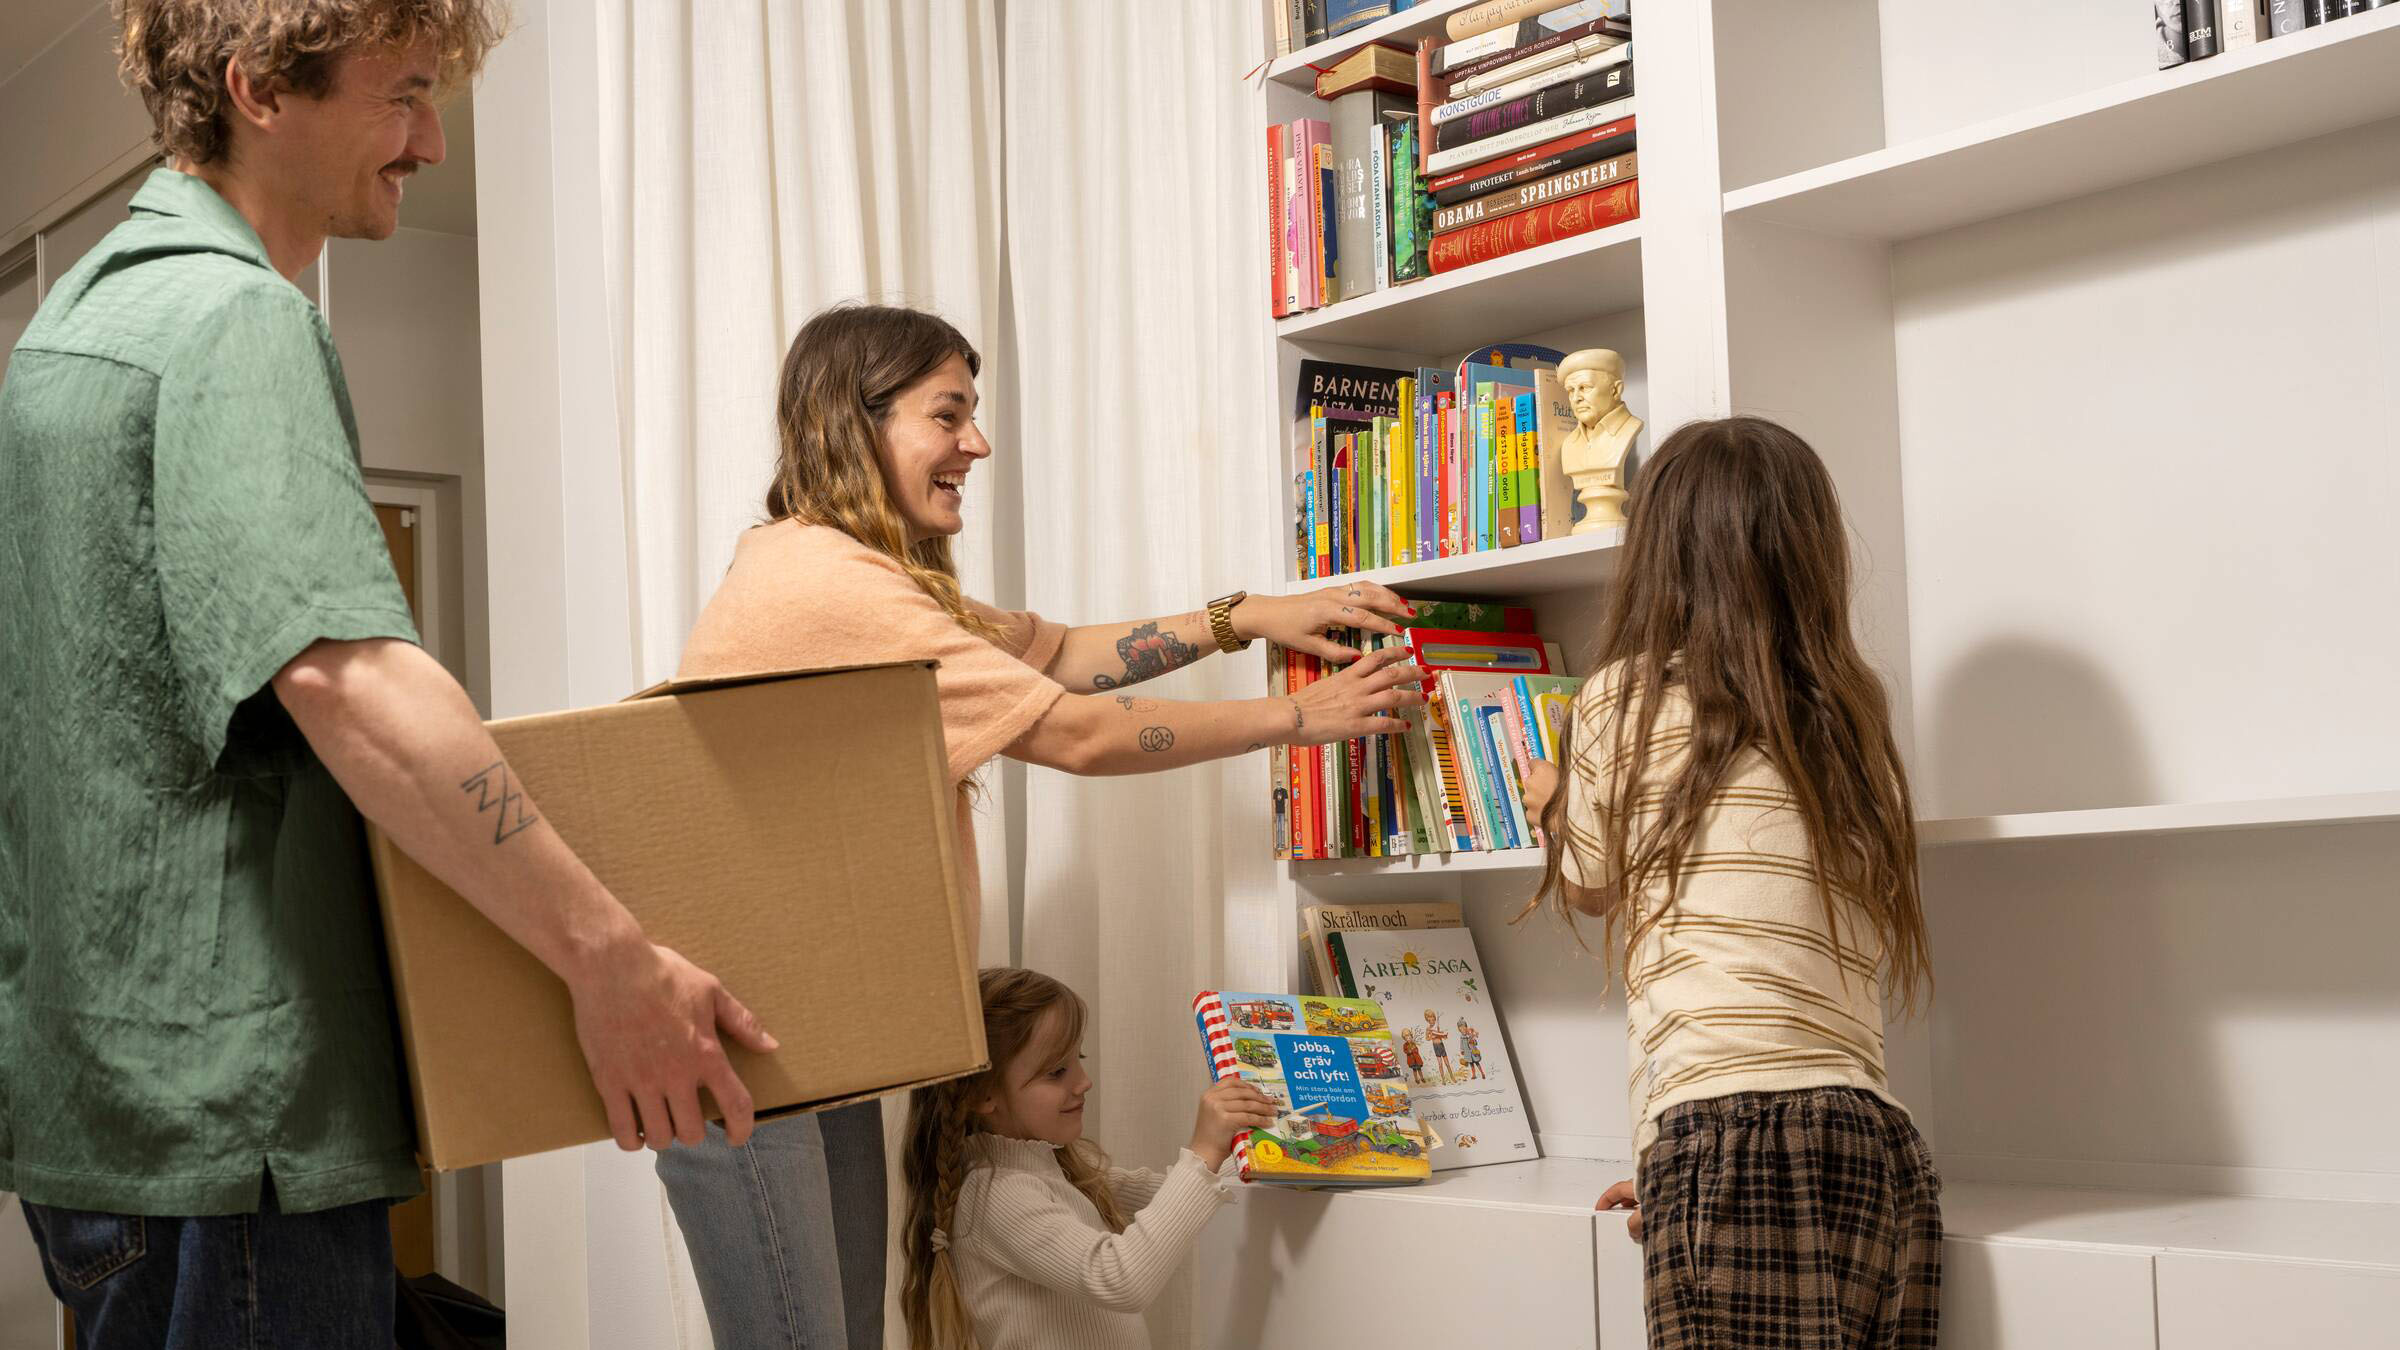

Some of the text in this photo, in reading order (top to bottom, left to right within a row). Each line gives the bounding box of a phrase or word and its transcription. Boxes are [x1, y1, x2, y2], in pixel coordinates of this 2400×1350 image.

[1454, 36, 1561, 78] UPPTÄCK VINPROVNING JANCIS ROBINSON
[1439, 89, 1501, 119] KONSTGUIDE
[1296, 160, 1304, 198] VELVET
[1470, 172, 1514, 191] HYPOTEKET
[1438, 161, 1618, 228] OBAMA SPRINGSTEEN
[1364, 404, 1399, 416] BIBE
[1553, 401, 1572, 417] Petit
[1500, 425, 1508, 456] första
[1501, 457, 1509, 476] 100
[1517, 694, 1538, 759] Astrid Lindgre
[1382, 910, 1408, 927] och
[1362, 958, 1472, 978] ÅRETS SAGA
[1292, 1041, 1335, 1055] Jobba,
[1303, 1055, 1332, 1068] gräv
[1294, 1068, 1350, 1083] och lyft!
[1298, 1093, 1357, 1103] arbetsfordon
[1421, 1104, 1514, 1121] erbok av Elsa Beskow
